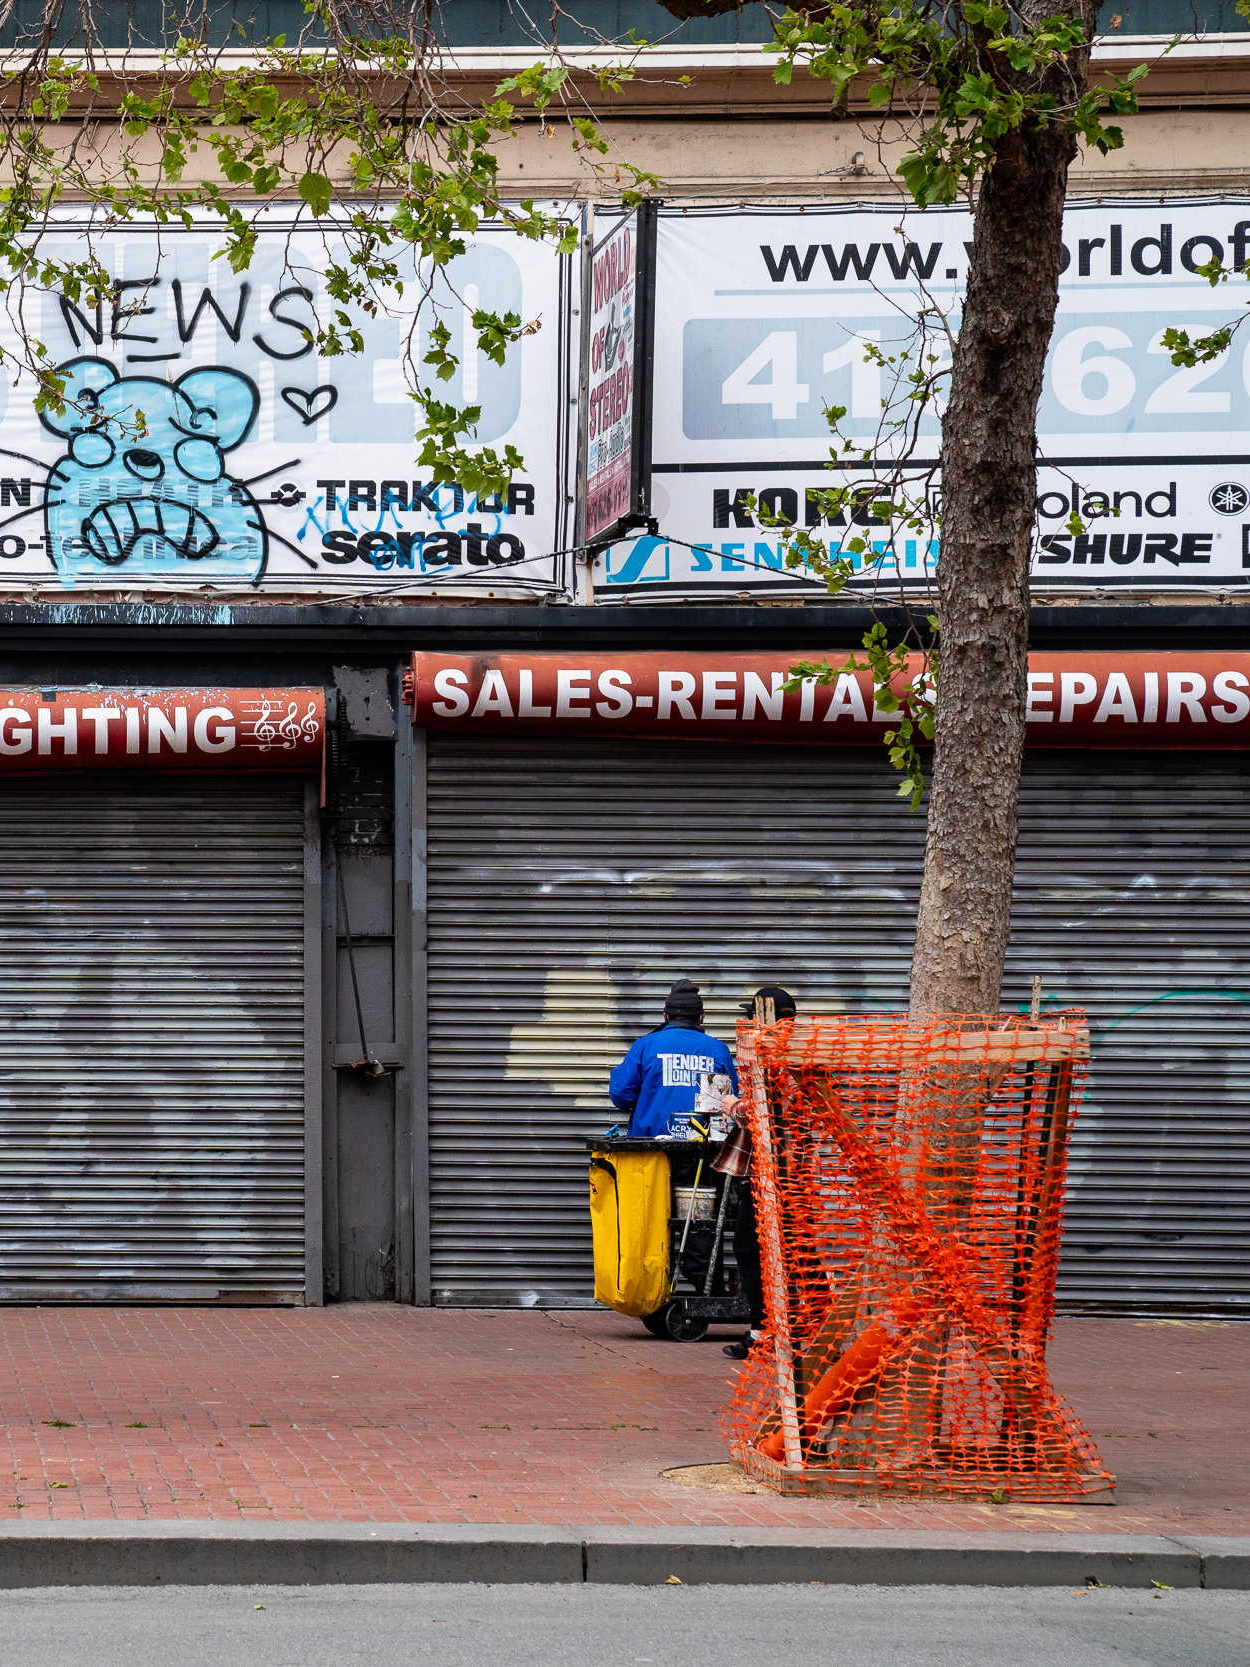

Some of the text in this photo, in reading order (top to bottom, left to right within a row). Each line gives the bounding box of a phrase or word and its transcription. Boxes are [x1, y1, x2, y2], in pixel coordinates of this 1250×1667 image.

[593, 227, 631, 314] WORLD
[58, 276, 315, 360] NEWS
[592, 325, 605, 374] OF
[1051, 322, 1250, 417] 62
[589, 361, 629, 440] STEREO
[713, 487, 893, 529] KORG
[1038, 481, 1177, 519] oland
[321, 523, 525, 566] serato
[1038, 533, 1214, 568] SHURE
[1026, 671, 1250, 724] EPAIRS
[657, 1053, 714, 1086] TENDER
